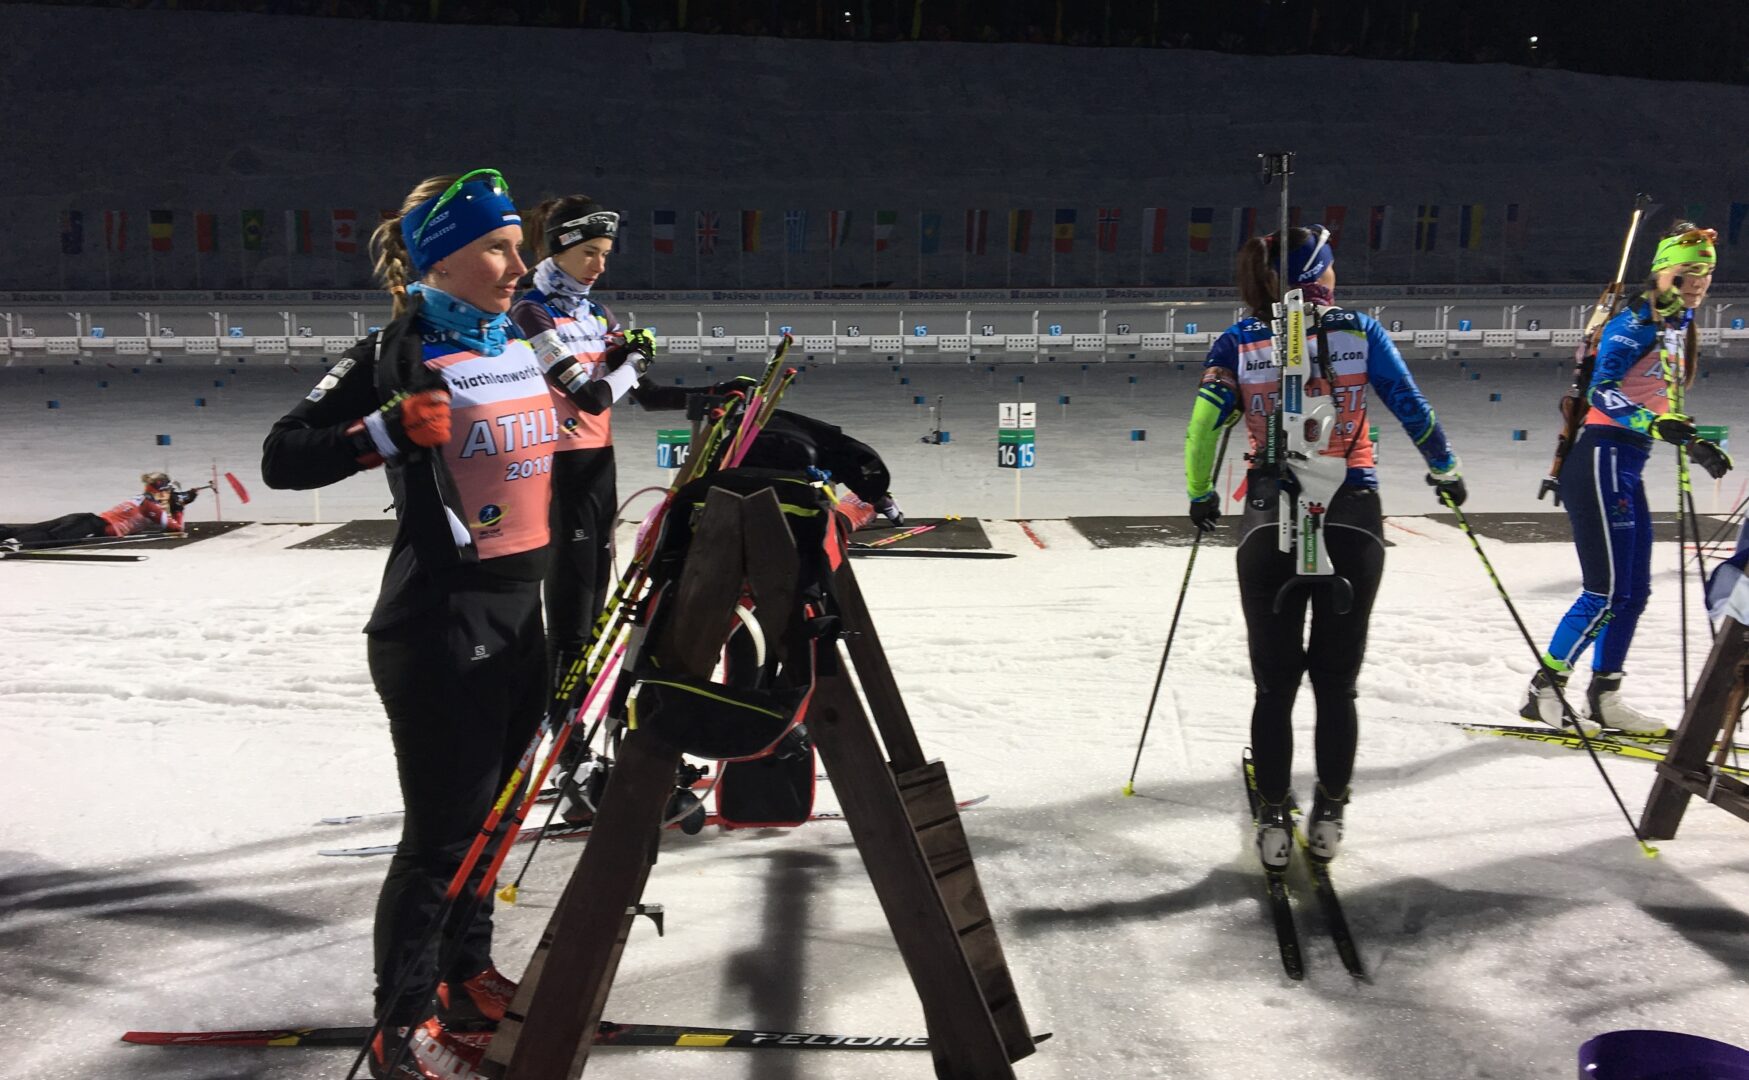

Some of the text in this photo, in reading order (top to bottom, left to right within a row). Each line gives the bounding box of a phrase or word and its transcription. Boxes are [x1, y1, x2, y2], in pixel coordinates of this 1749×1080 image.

[1326, 312, 1354, 323] 330
[1117, 324, 1129, 335] 12
[1186, 324, 1198, 335] 11
[1392, 320, 1402, 332] 8
[1460, 319, 1469, 331] 7
[1529, 320, 1537, 331] 6
[1734, 318, 1743, 330] 3
[230, 327, 243, 338] 25
[712, 326, 724, 338] 18
[848, 326, 860, 337] 16
[914, 325, 927, 337] 15
[982, 325, 994, 336] 14
[1049, 325, 1062, 336] 13
[1609, 334, 1641, 349] ATEX
[657, 443, 671, 467] 17
[999, 443, 1035, 467] 16 15
[1501, 731, 1622, 754] FISCHER
